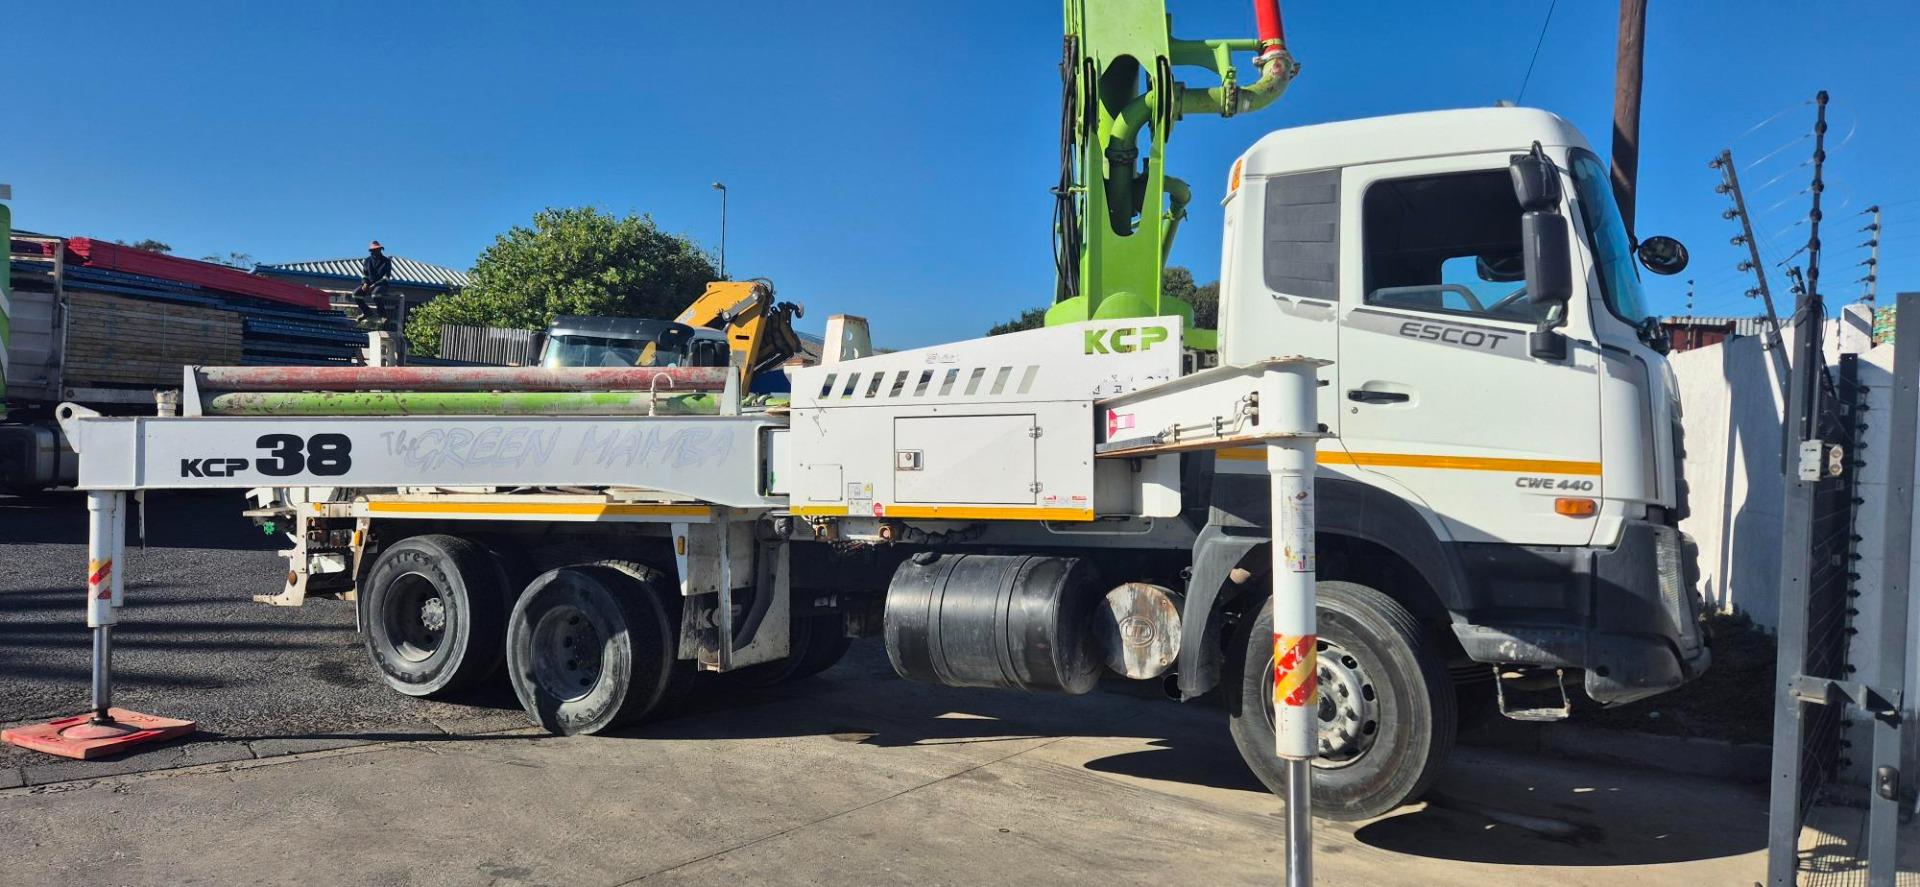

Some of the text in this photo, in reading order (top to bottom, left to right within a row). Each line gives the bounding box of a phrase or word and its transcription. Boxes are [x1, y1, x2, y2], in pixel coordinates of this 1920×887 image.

[1084, 326, 1168, 355] KCP
[1400, 322, 1508, 349] ESCOT
[181, 433, 352, 477] KCP 38
[379, 425, 736, 472] The GREEN MAMBA
[1515, 477, 1594, 491] CWE 440
